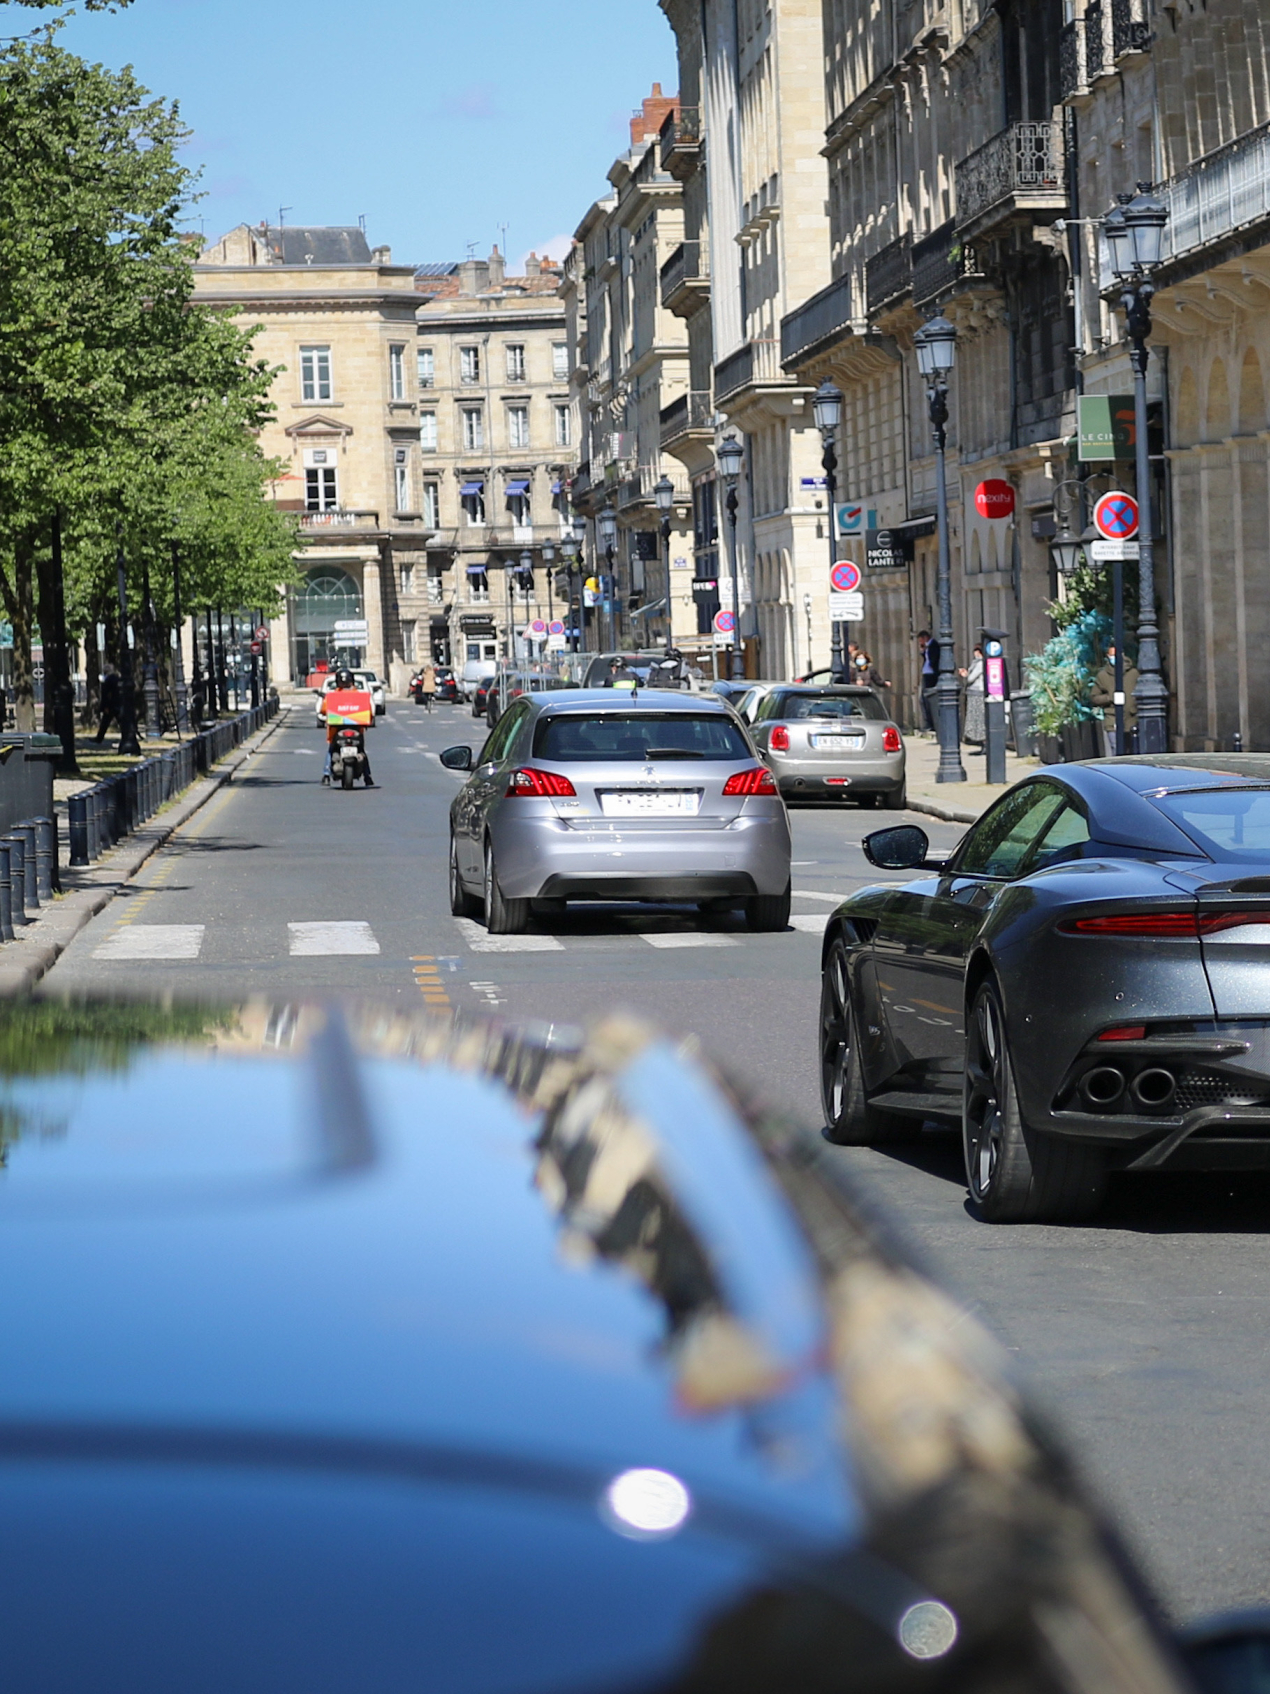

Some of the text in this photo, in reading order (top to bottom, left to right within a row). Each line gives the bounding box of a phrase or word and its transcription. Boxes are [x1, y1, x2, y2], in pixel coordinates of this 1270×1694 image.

[1081, 433, 1094, 441] LE
[977, 493, 1011, 503] nexity
[868, 549, 904, 558] NICOLAS
[990, 641, 1002, 656] P
